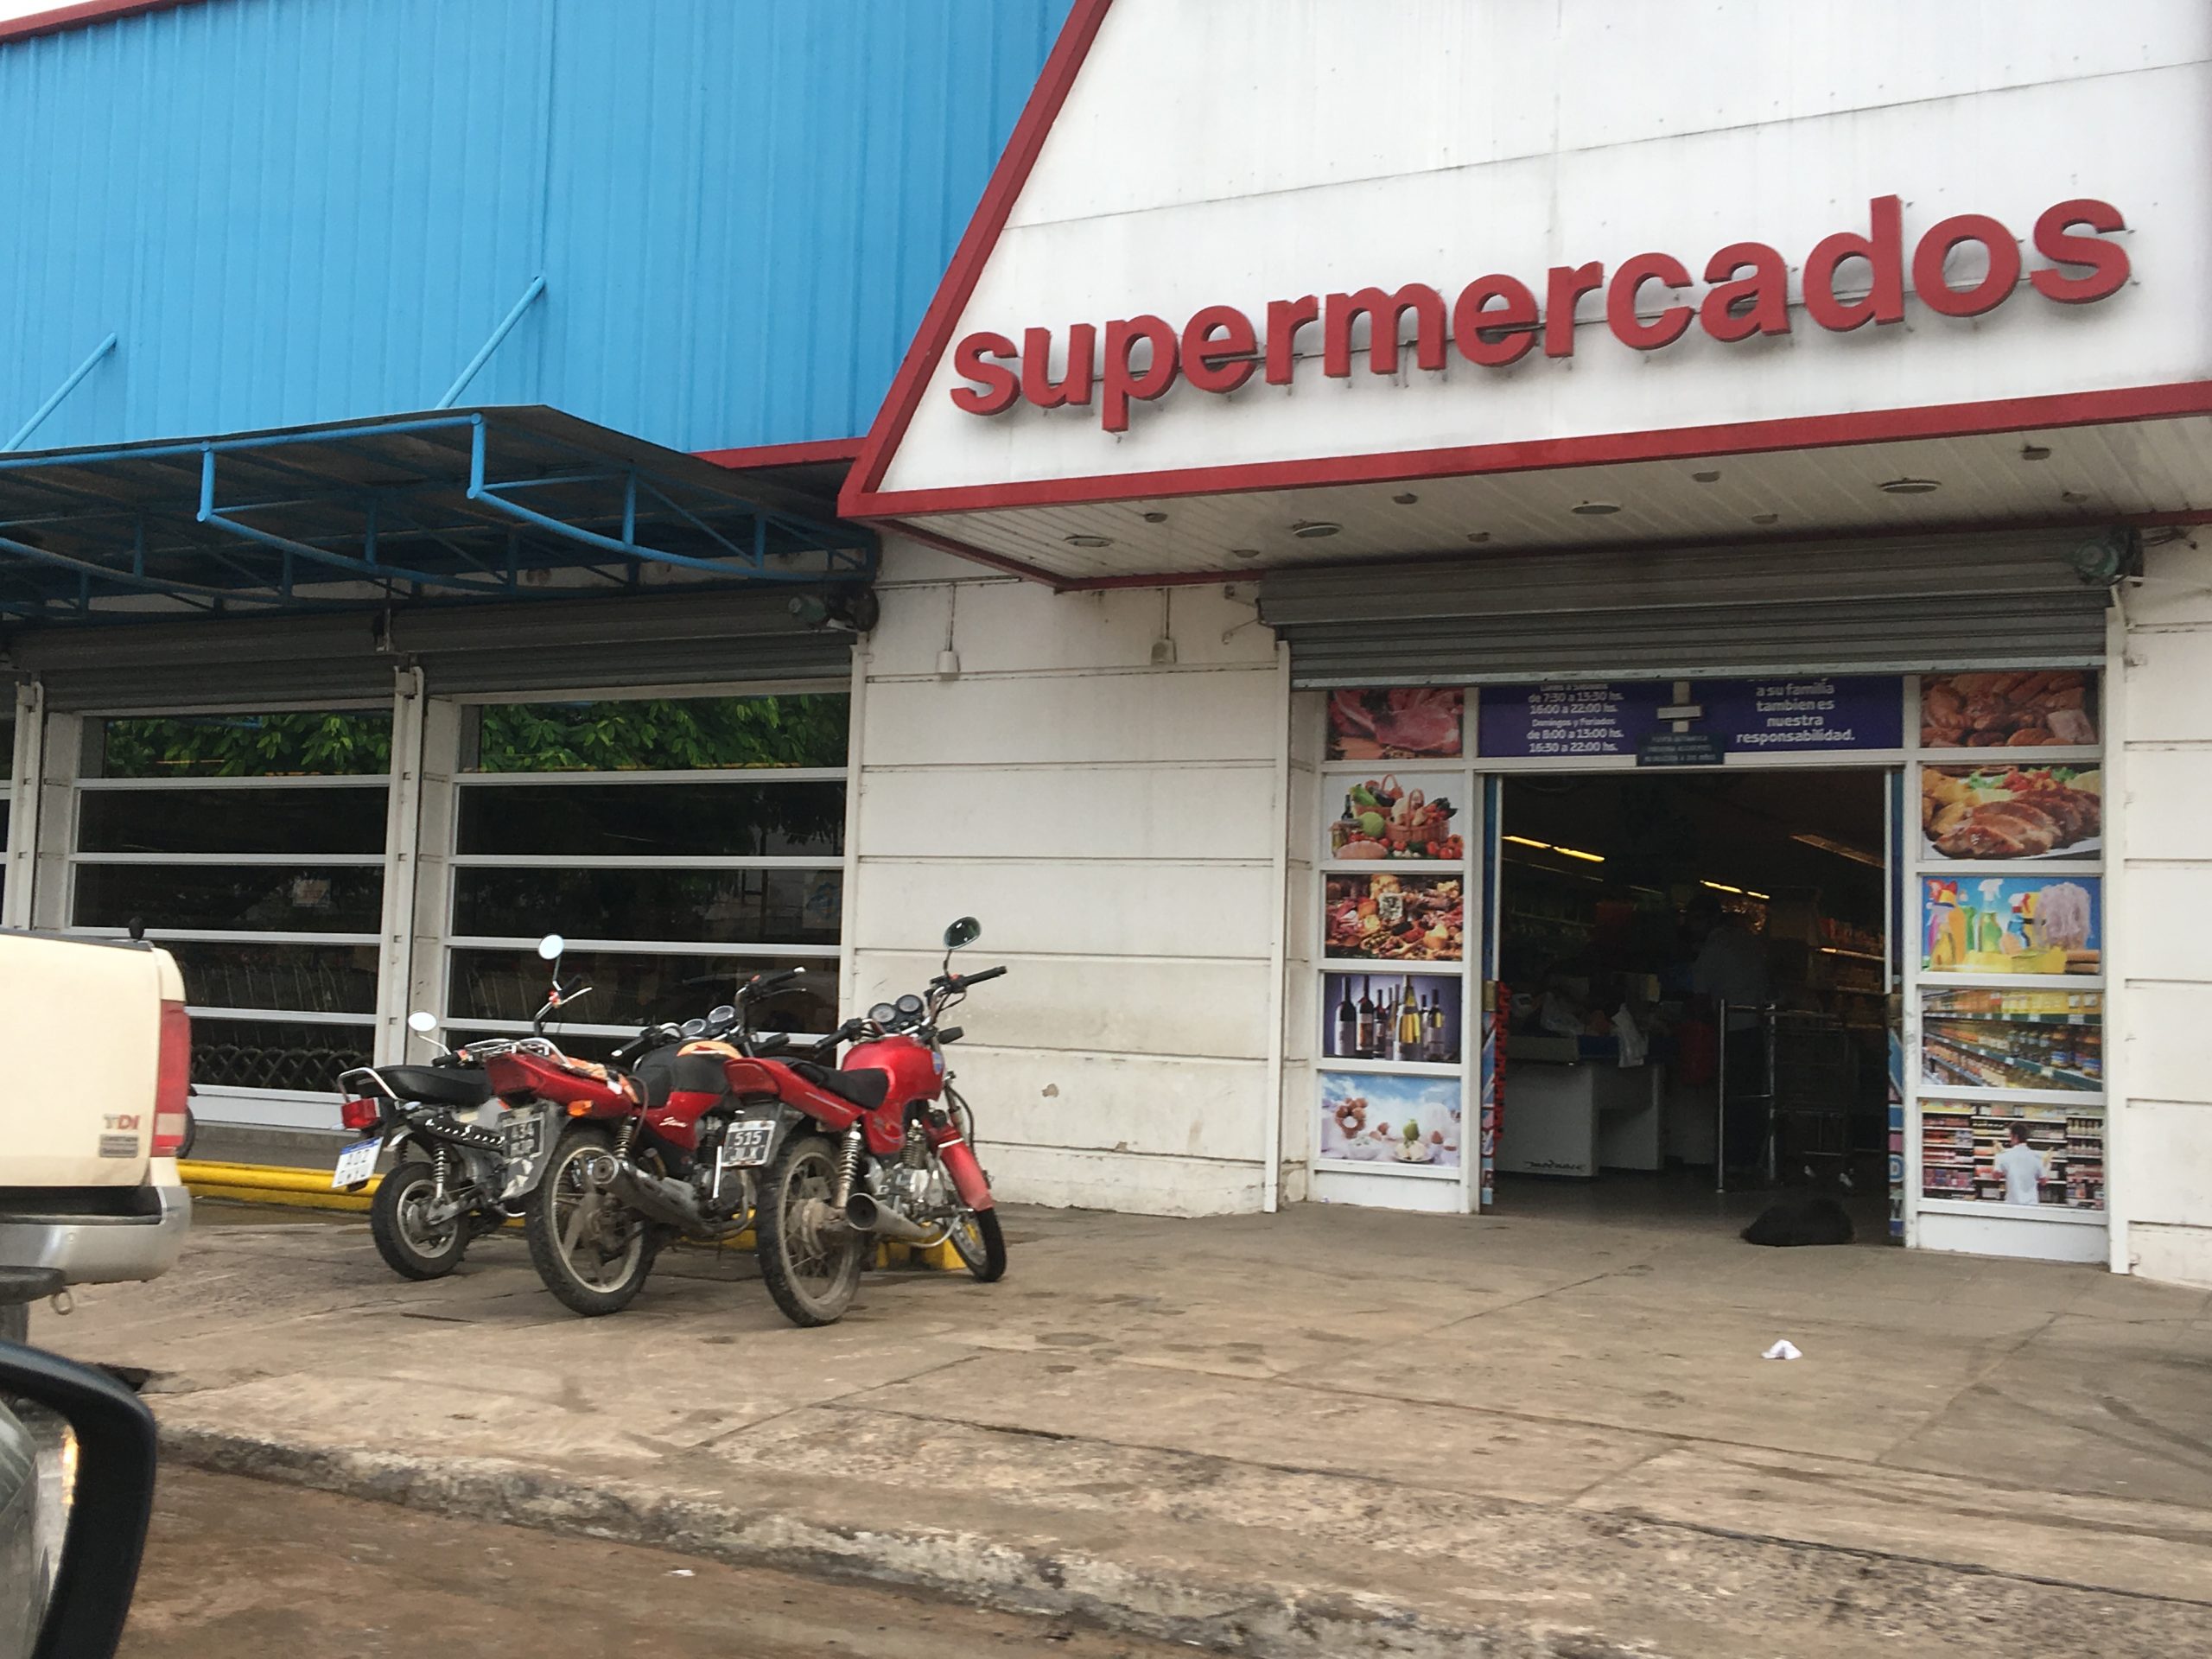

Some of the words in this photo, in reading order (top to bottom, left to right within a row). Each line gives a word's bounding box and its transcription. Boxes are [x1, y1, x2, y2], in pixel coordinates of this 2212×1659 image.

[950, 194, 2133, 432] supermercados
[1766, 685, 1784, 696] su
[1785, 683, 1834, 696] familia
[1528, 693, 1541, 703] de
[1561, 705, 1569, 714] a
[1570, 702, 1602, 715] 22:00
[1756, 698, 1815, 712] tambien
[1817, 699, 1835, 710] es
[1766, 715, 1824, 727] nuestra
[1526, 729, 1541, 740] de
[1567, 730, 1576, 739] a
[1736, 728, 1855, 746] responsabilidad.
[1560, 744, 1569, 753] a
[1569, 741, 1601, 753] 22:00
[103, 1113, 140, 1130] TDI
[734, 1130, 763, 1146] 515
